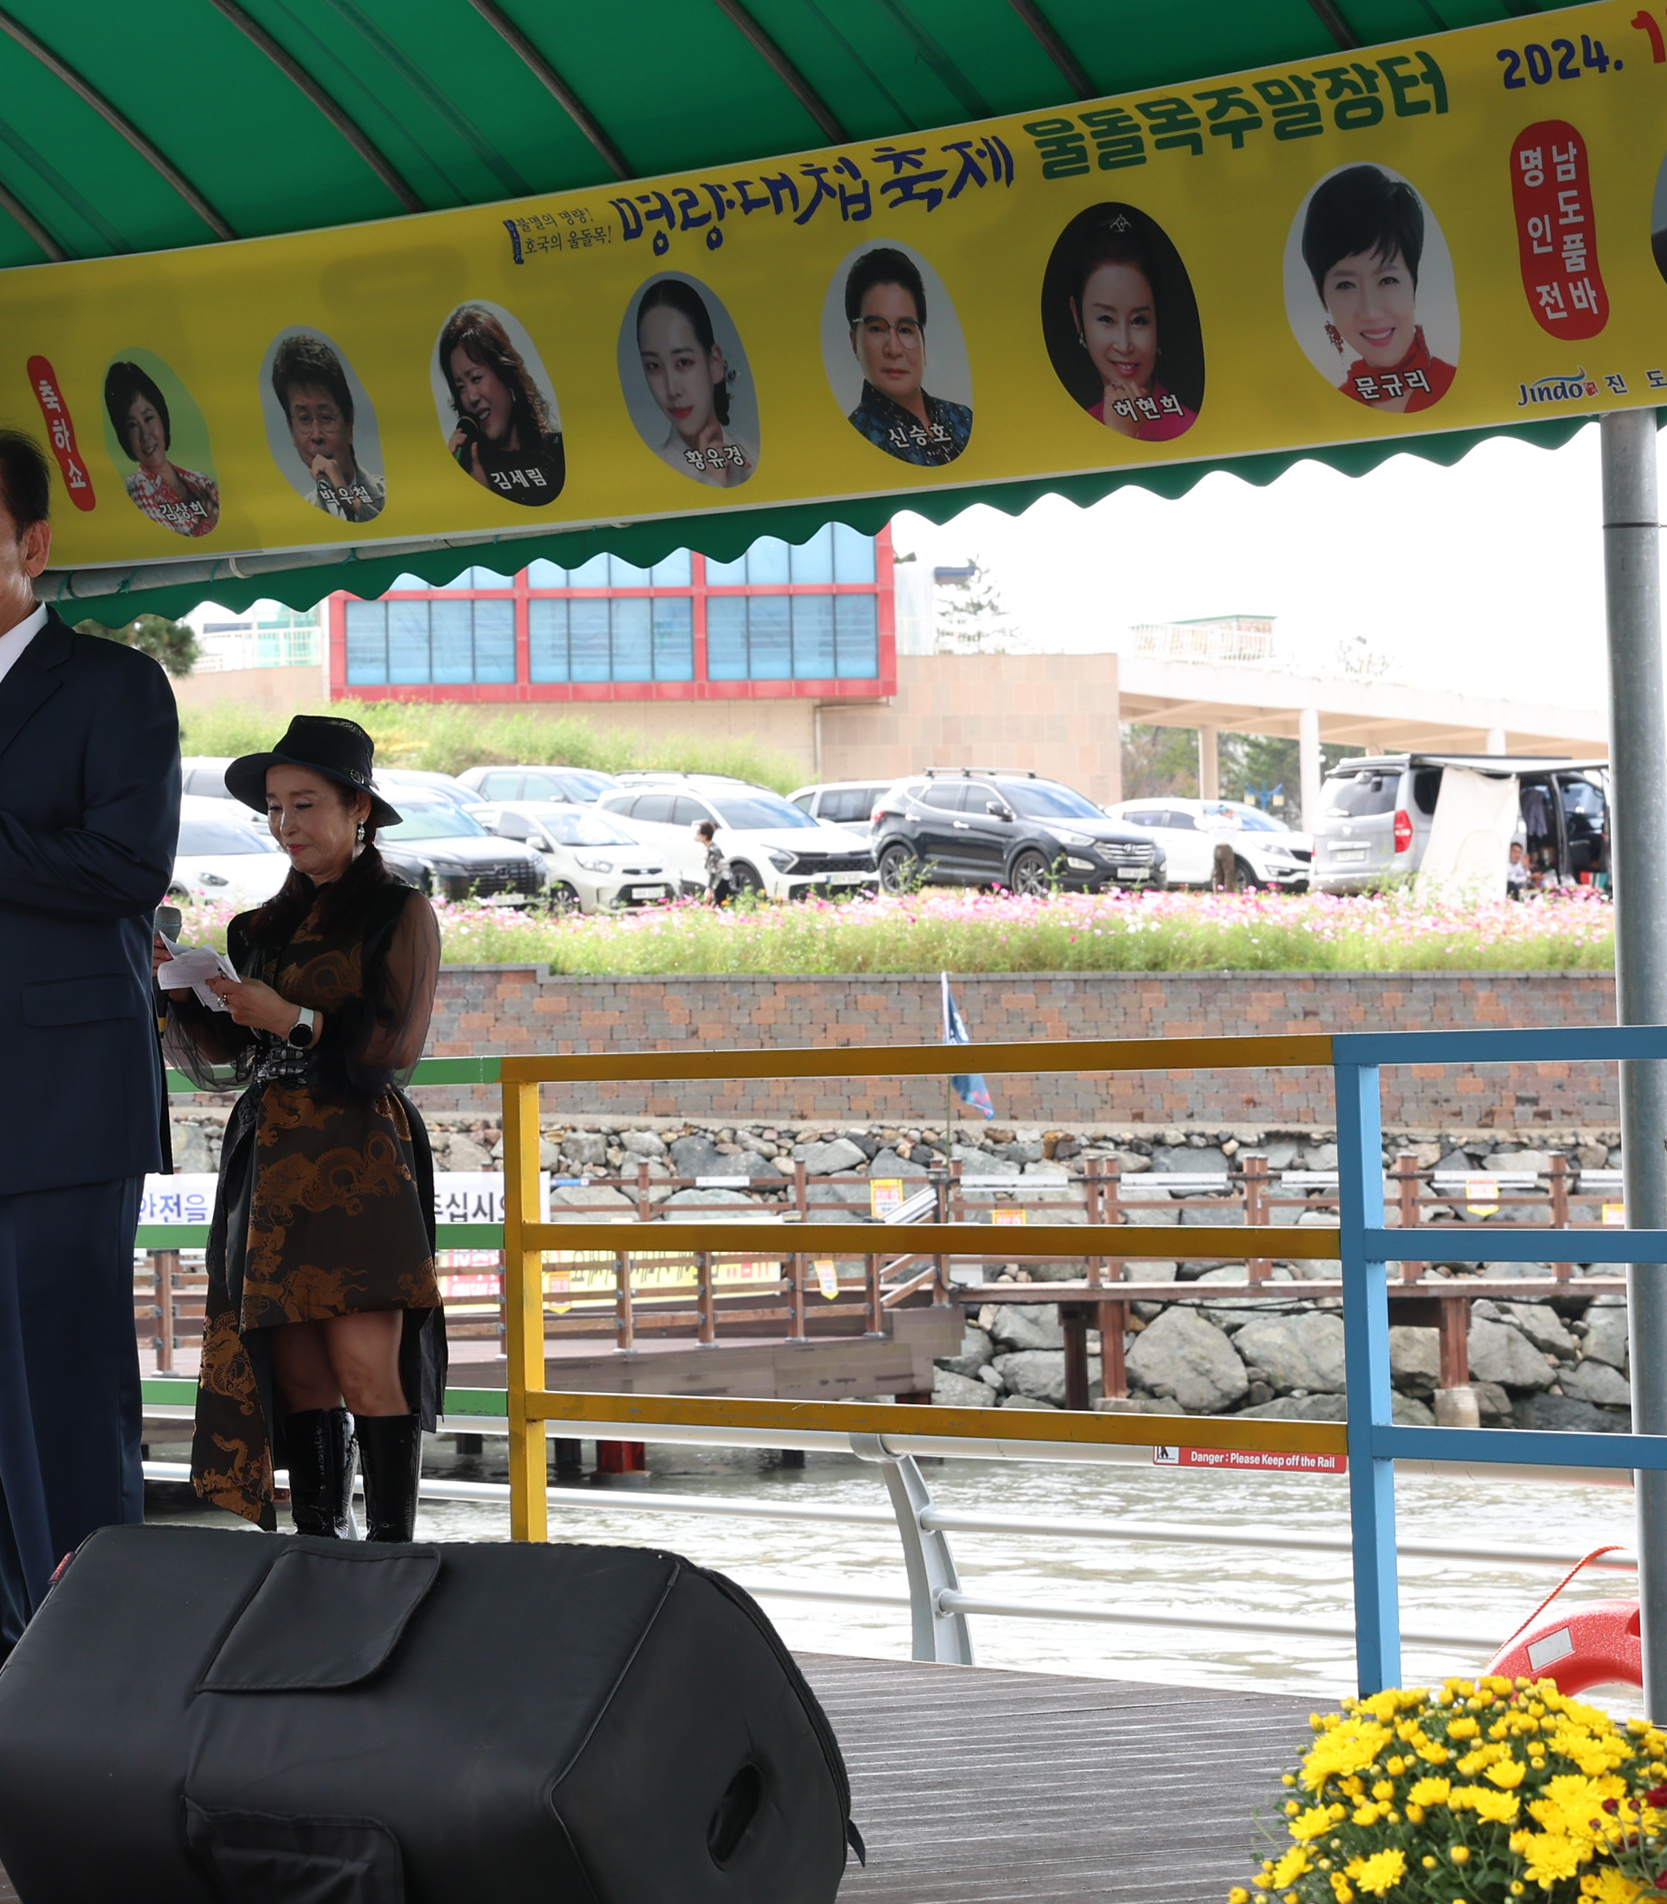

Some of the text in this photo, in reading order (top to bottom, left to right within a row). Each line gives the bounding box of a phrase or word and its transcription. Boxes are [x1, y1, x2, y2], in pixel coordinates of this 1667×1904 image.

[1496, 34, 1623, 89] 2024.
[1022, 50, 1449, 180] 울돌목주말장터
[515, 212, 558, 233] 불멸의
[524, 232, 562, 254] 호국의
[568, 225, 611, 250] 울돌목!
[1353, 368, 1431, 401] 문규리
[1517, 379, 1583, 406] Jindo
[1114, 393, 1185, 422] 허현희
[39, 379, 87, 488] 축하쇼
[888, 423, 953, 449] 신승호
[684, 445, 746, 471] 황유경
[491, 467, 548, 490] 김세림
[319, 485, 374, 507] 박우철
[158, 501, 208, 522] 김상희
[1191, 1451, 1224, 1463] Danger
[1230, 1453, 1260, 1465] Please
[1262, 1454, 1284, 1467] Keep
[1286, 1455, 1300, 1466] off
[1301, 1456, 1315, 1467] the
[1317, 1457, 1335, 1468] Rail
